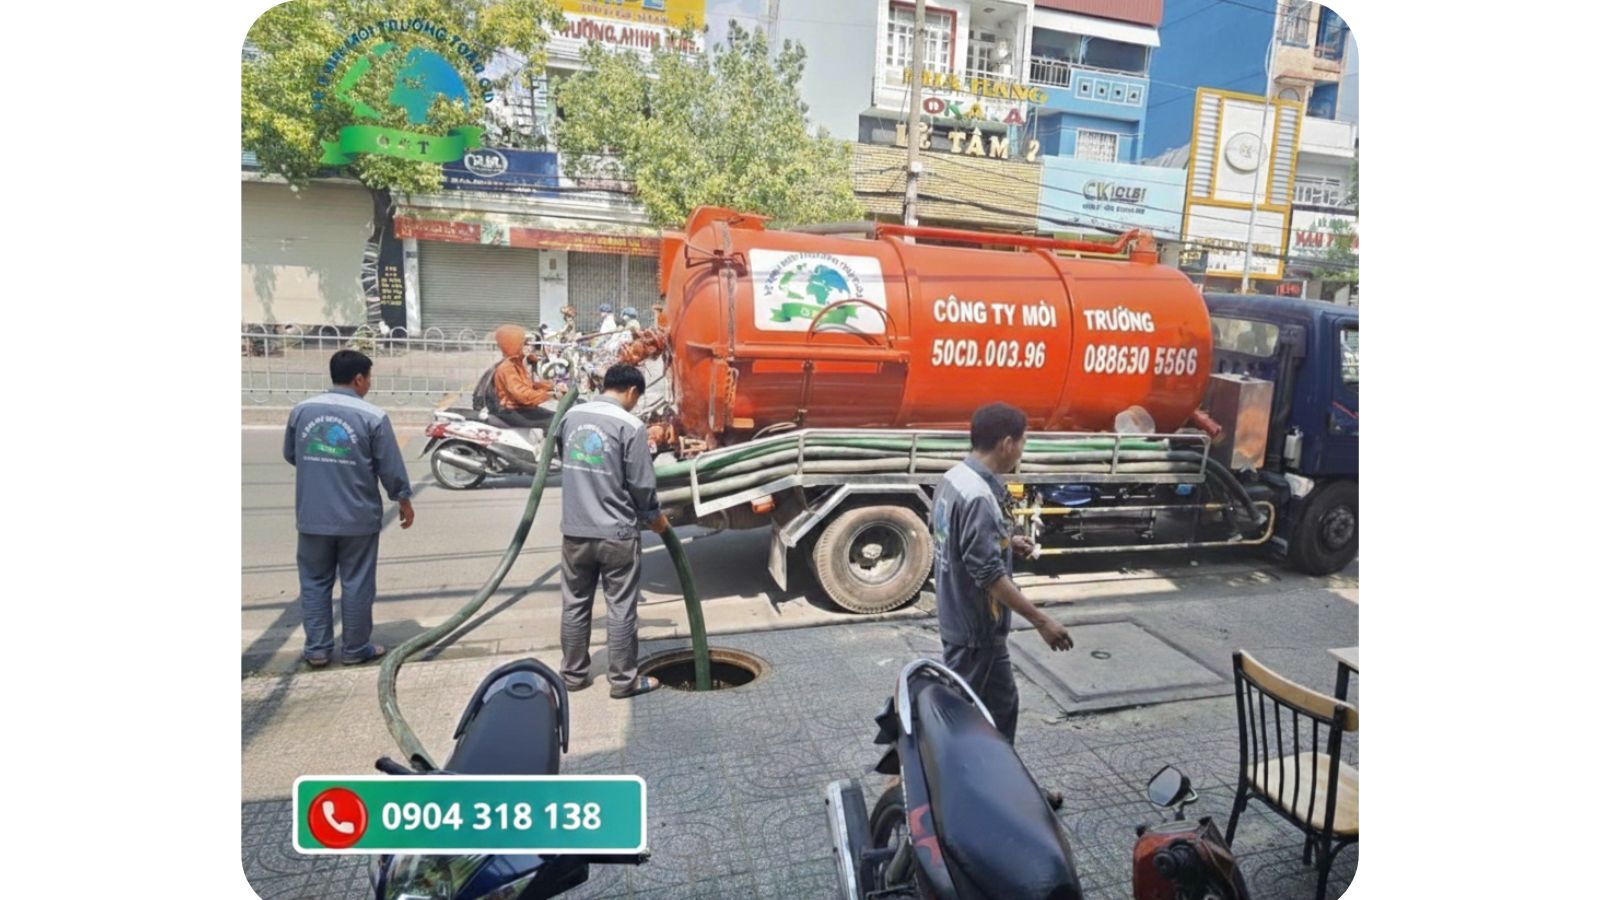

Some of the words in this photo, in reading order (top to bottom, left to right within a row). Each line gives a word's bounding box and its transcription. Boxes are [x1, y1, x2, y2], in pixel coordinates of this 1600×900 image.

[948, 127, 1010, 159] TÂM
[933, 294, 988, 324] CÔNG
[991, 303, 1016, 326] TY
[1083, 305, 1155, 333] TRƯỜNG
[931, 339, 1046, 368] 50CD.003.96
[1084, 343, 1150, 374] 088630
[1154, 346, 1198, 376] 5566
